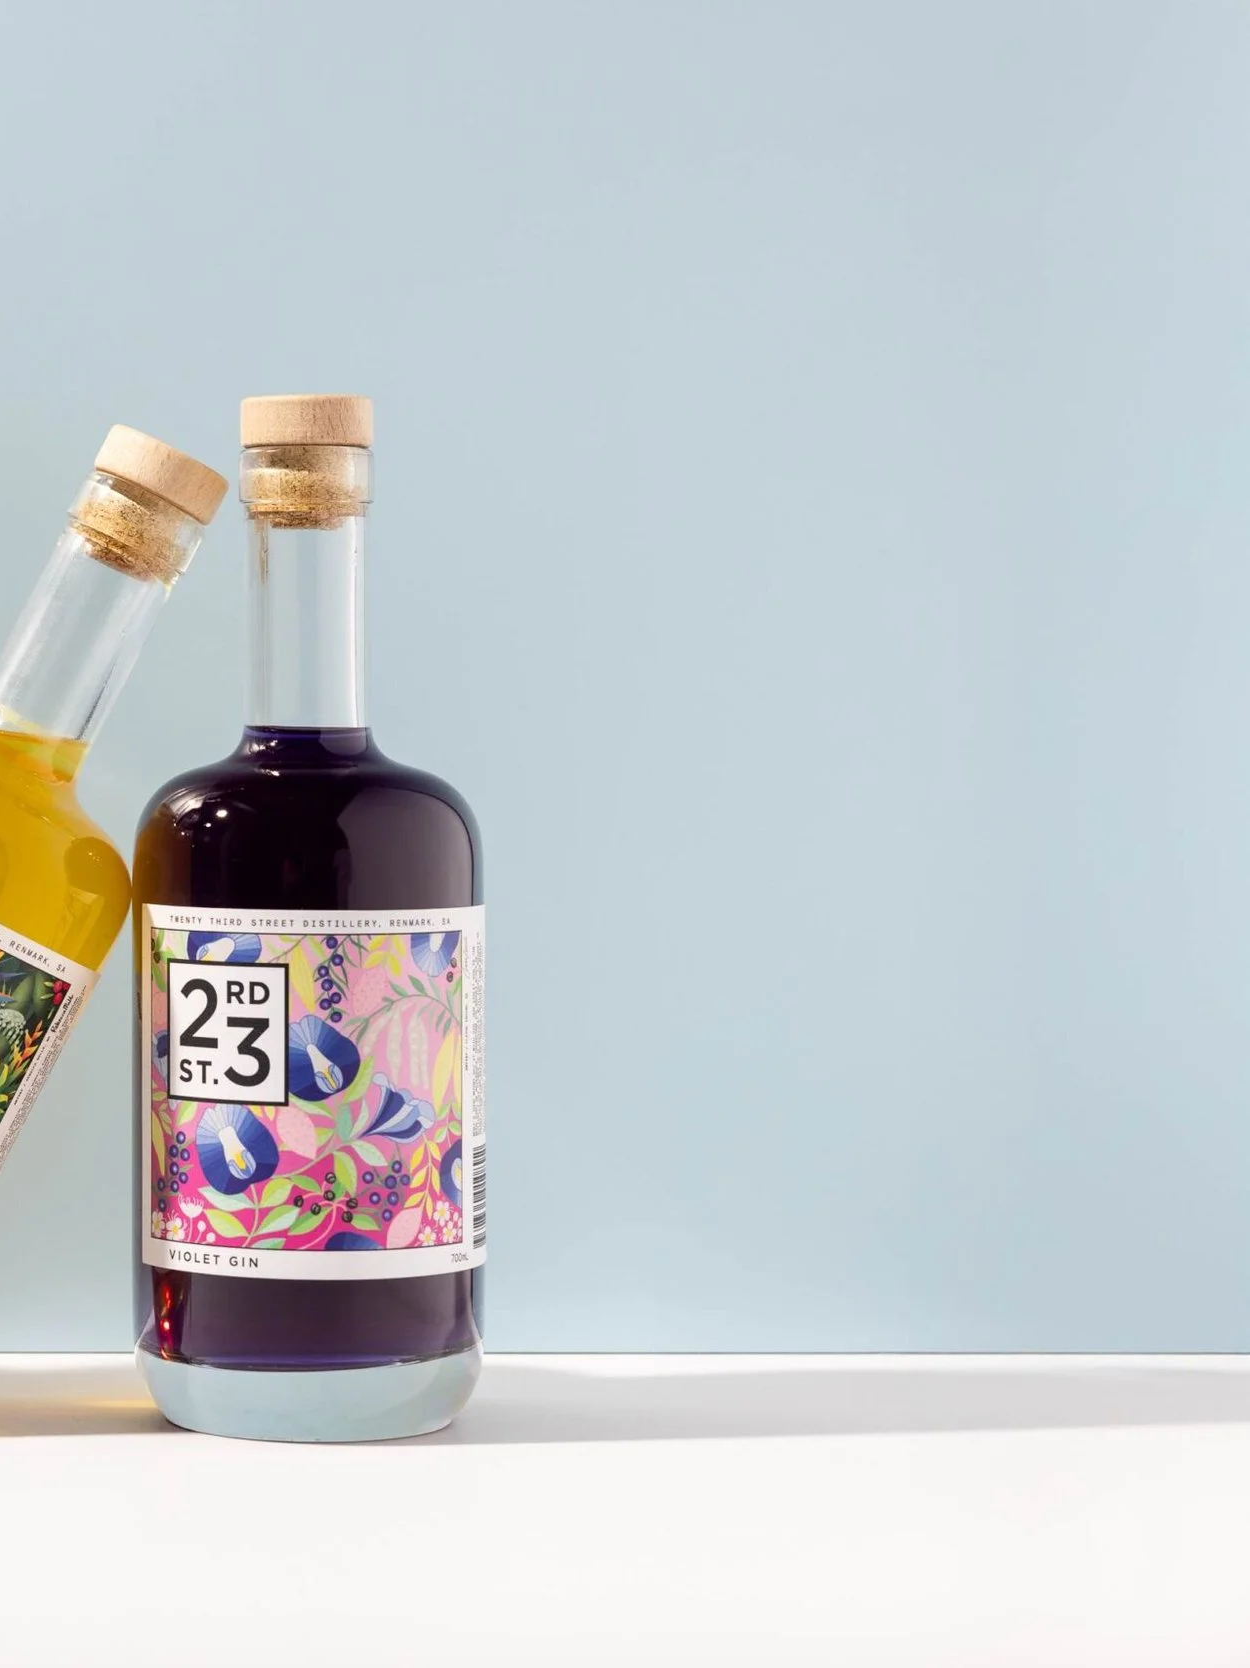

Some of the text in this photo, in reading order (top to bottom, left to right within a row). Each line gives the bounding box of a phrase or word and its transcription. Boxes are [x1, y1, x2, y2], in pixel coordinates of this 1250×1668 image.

[169, 914, 202, 924] TWENTY
[209, 917, 243, 927] THIRD
[250, 918, 295, 928] STREET
[302, 919, 381, 928] DISTILLERY,
[389, 918, 436, 929] RENMARK,
[10, 940, 50, 967] RENMARK,
[179, 978, 271, 1050] 2 RD
[179, 1016, 271, 1088] ST. 3
[168, 1248, 259, 1268] VIOLET GIN
